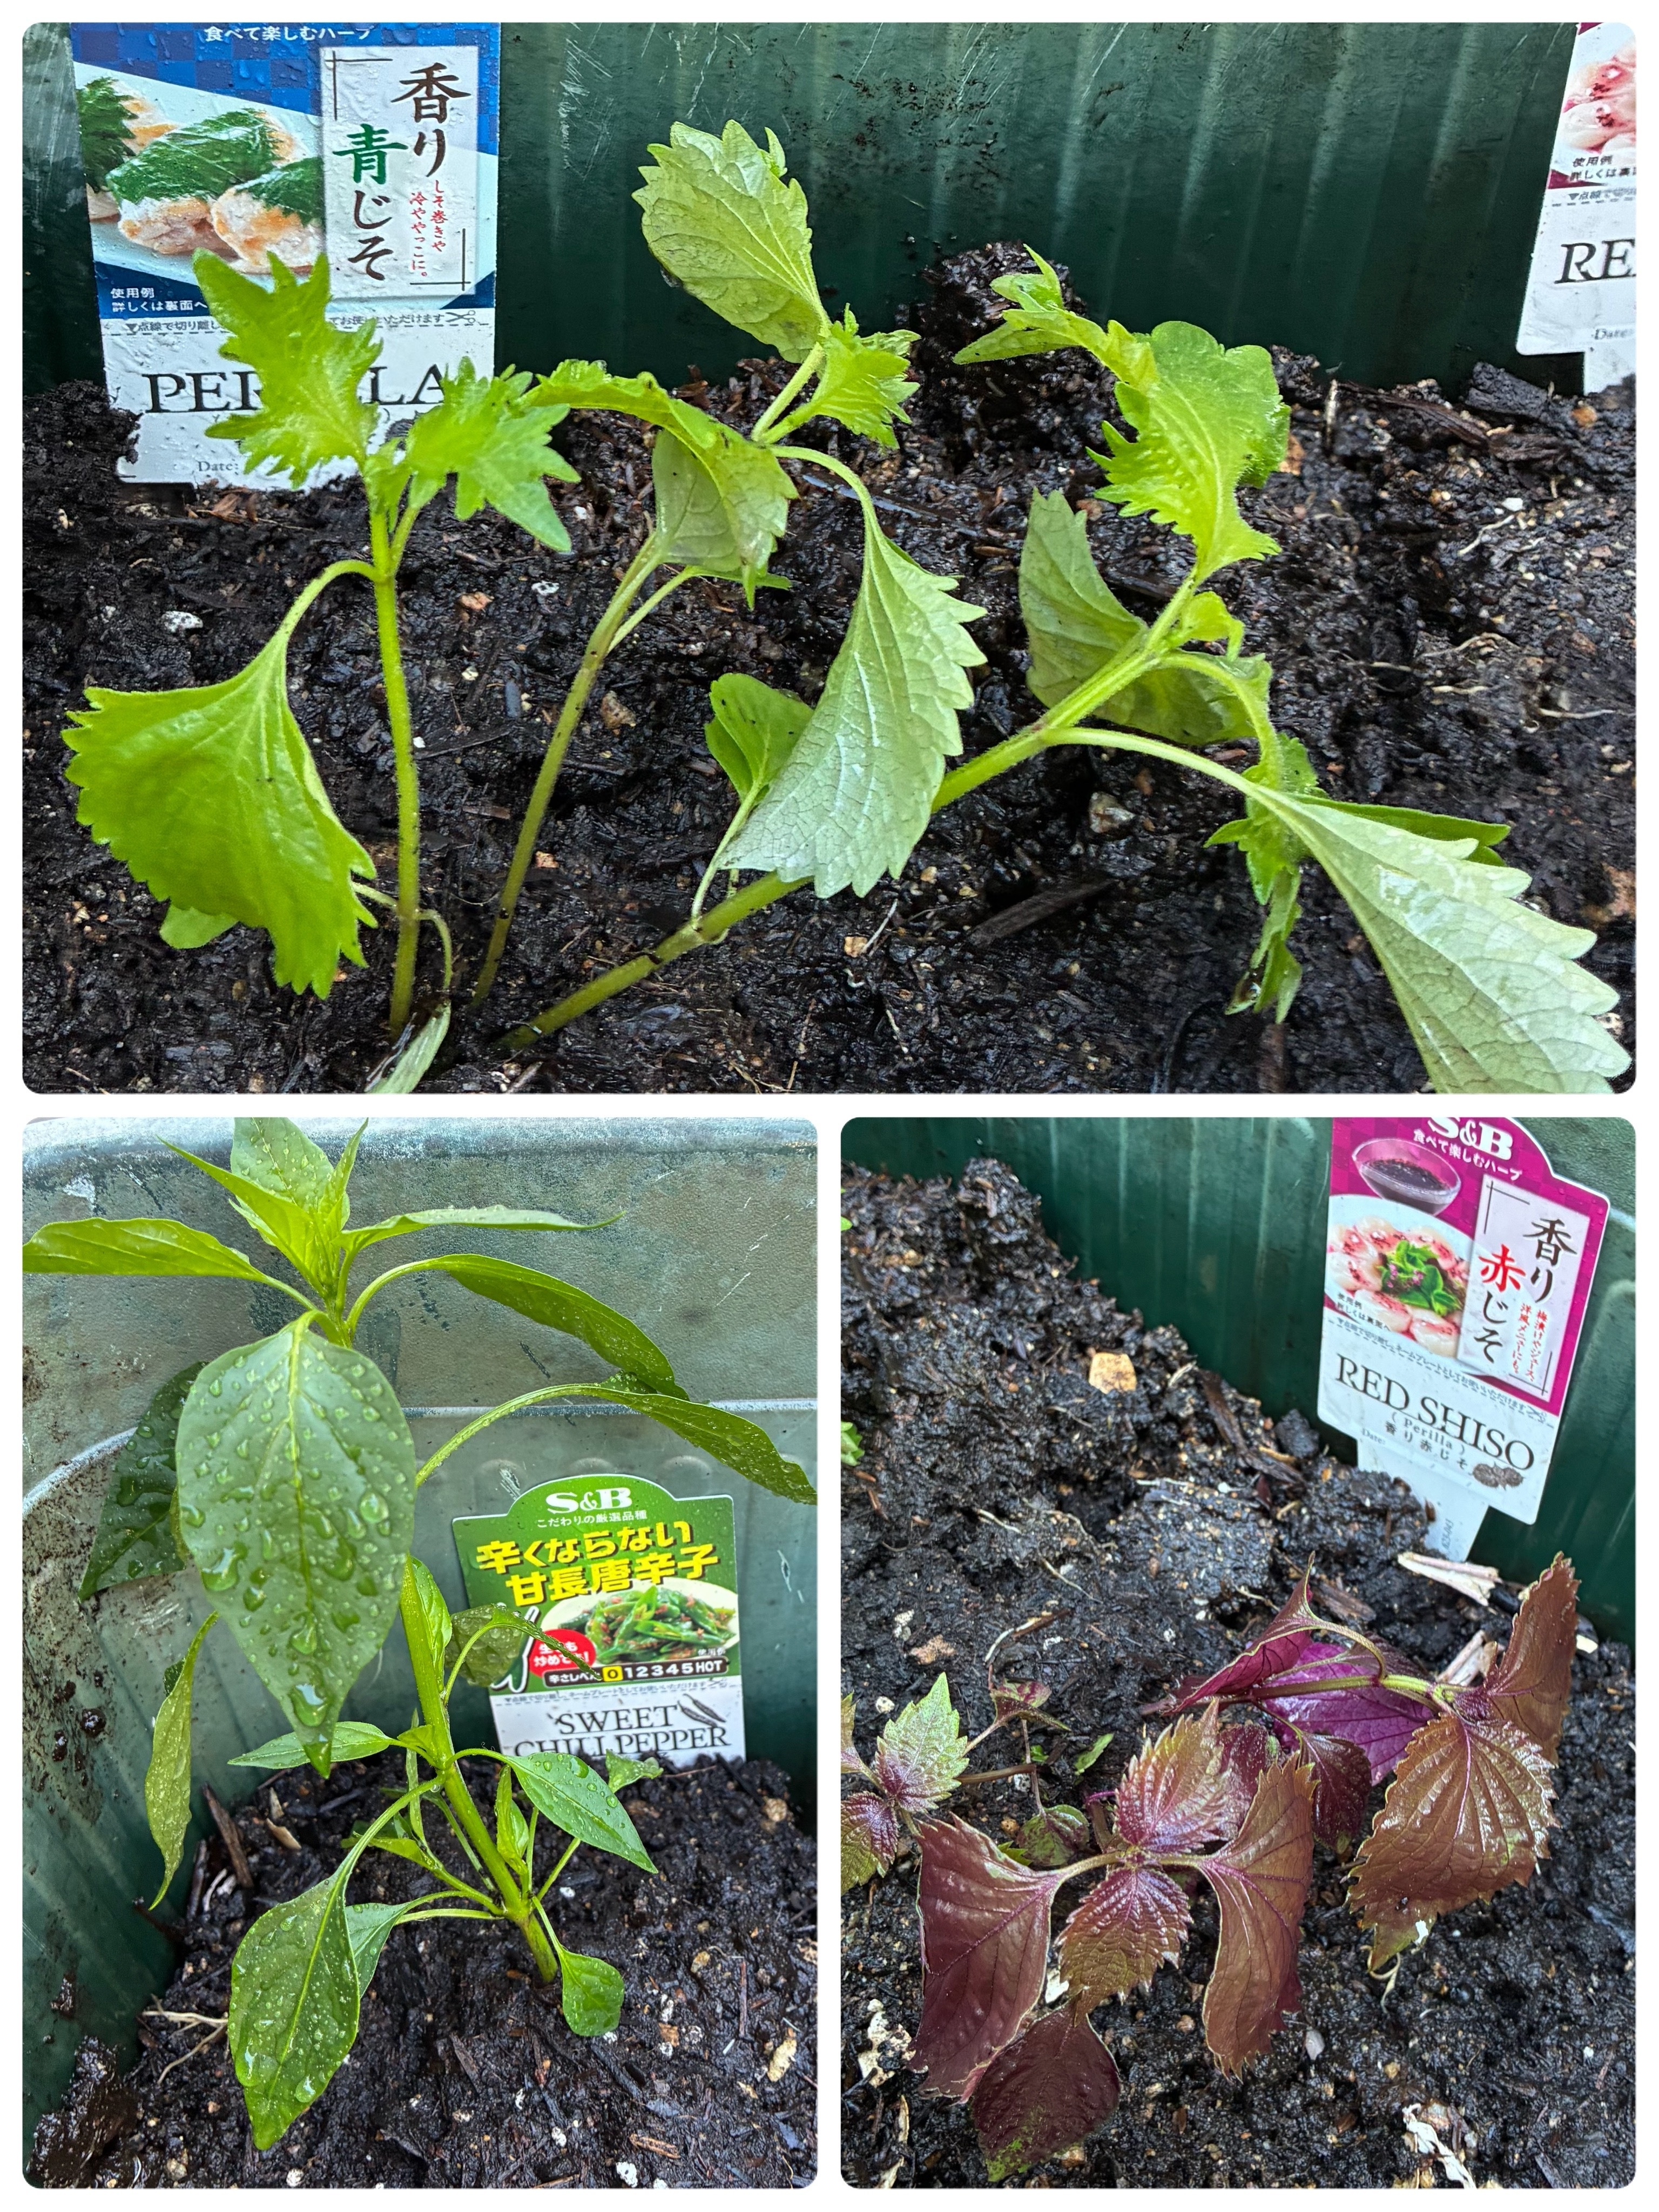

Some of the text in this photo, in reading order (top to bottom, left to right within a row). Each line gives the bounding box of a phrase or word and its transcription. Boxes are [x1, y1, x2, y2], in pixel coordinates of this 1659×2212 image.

[391, 62, 471, 177] 香り
[332, 123, 409, 281] 青じそ
[430, 180, 448, 252] しそ巻きや
[111, 287, 155, 299] 使用例
[112, 300, 207, 312] 詳しくは裏面へ
[198, 460, 238, 473] Date:
[1428, 1117, 1513, 1160] S&B
[1523, 1218, 1577, 1303] 香り
[1474, 1244, 1526, 1363] 赤じそ
[1336, 1353, 1535, 1470] RED SHISO
[545, 1487, 632, 1514] S&B
[537, 1510, 648, 1528] こだわりの厳選品種
[476, 1521, 692, 1574] 辛くならない
[505, 1543, 719, 1607] 甘長唐辛子
[539, 1641, 578, 1654] 生も
[696, 1660, 723, 1673] HOT
[558, 1705, 677, 1735] SWEET
[615, 1727, 732, 1755] PEPPER
